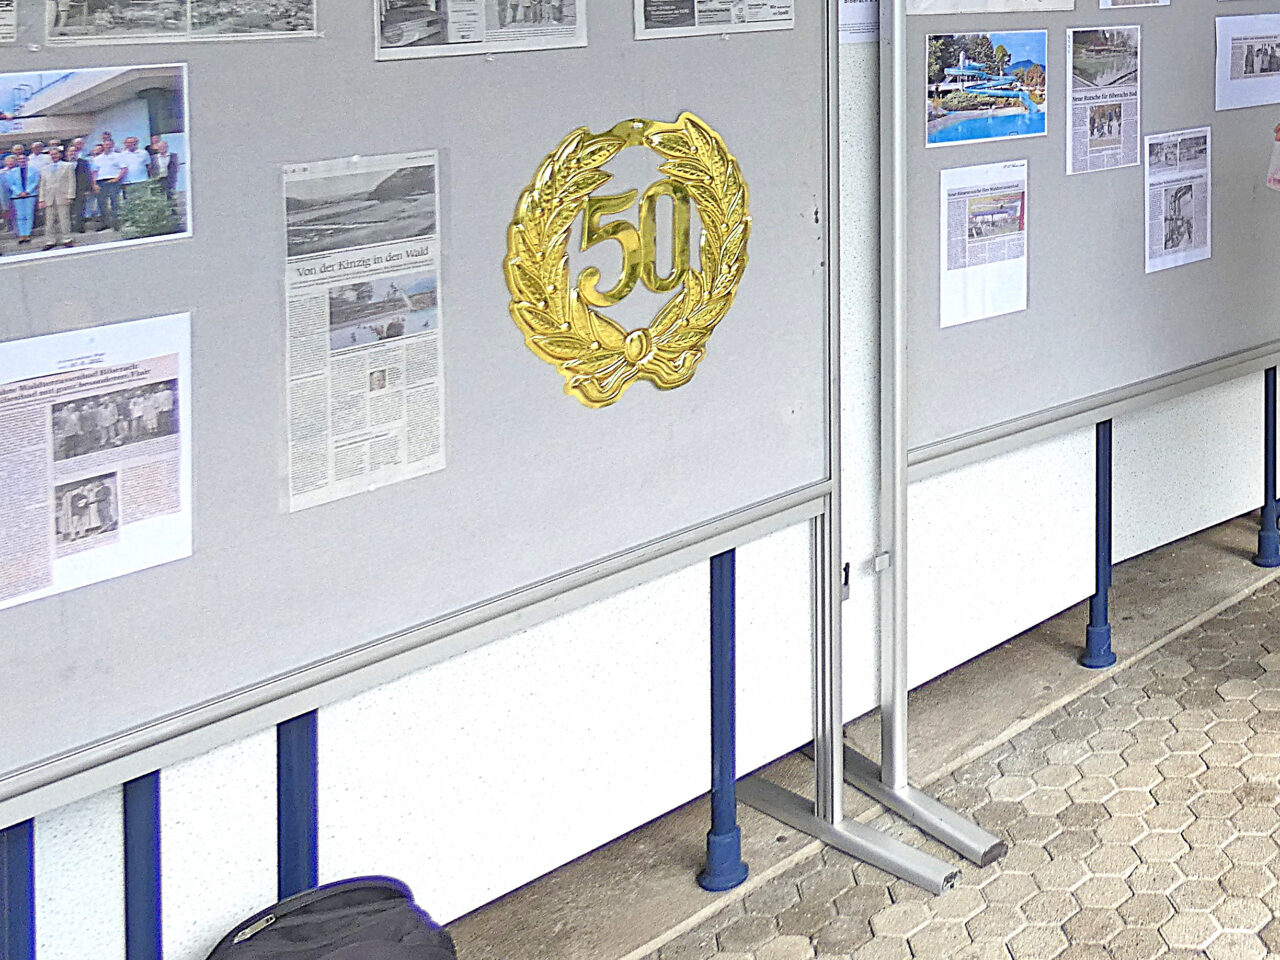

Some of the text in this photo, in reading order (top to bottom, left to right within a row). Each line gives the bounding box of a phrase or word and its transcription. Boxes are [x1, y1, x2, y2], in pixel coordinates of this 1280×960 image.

[296, 267, 317, 277] Von
[319, 263, 336, 274] der
[338, 257, 371, 271] Kinzig
[373, 255, 383, 265] in
[385, 251, 403, 263] den
[405, 245, 429, 258] Wald
[577, 177, 691, 308] 50
